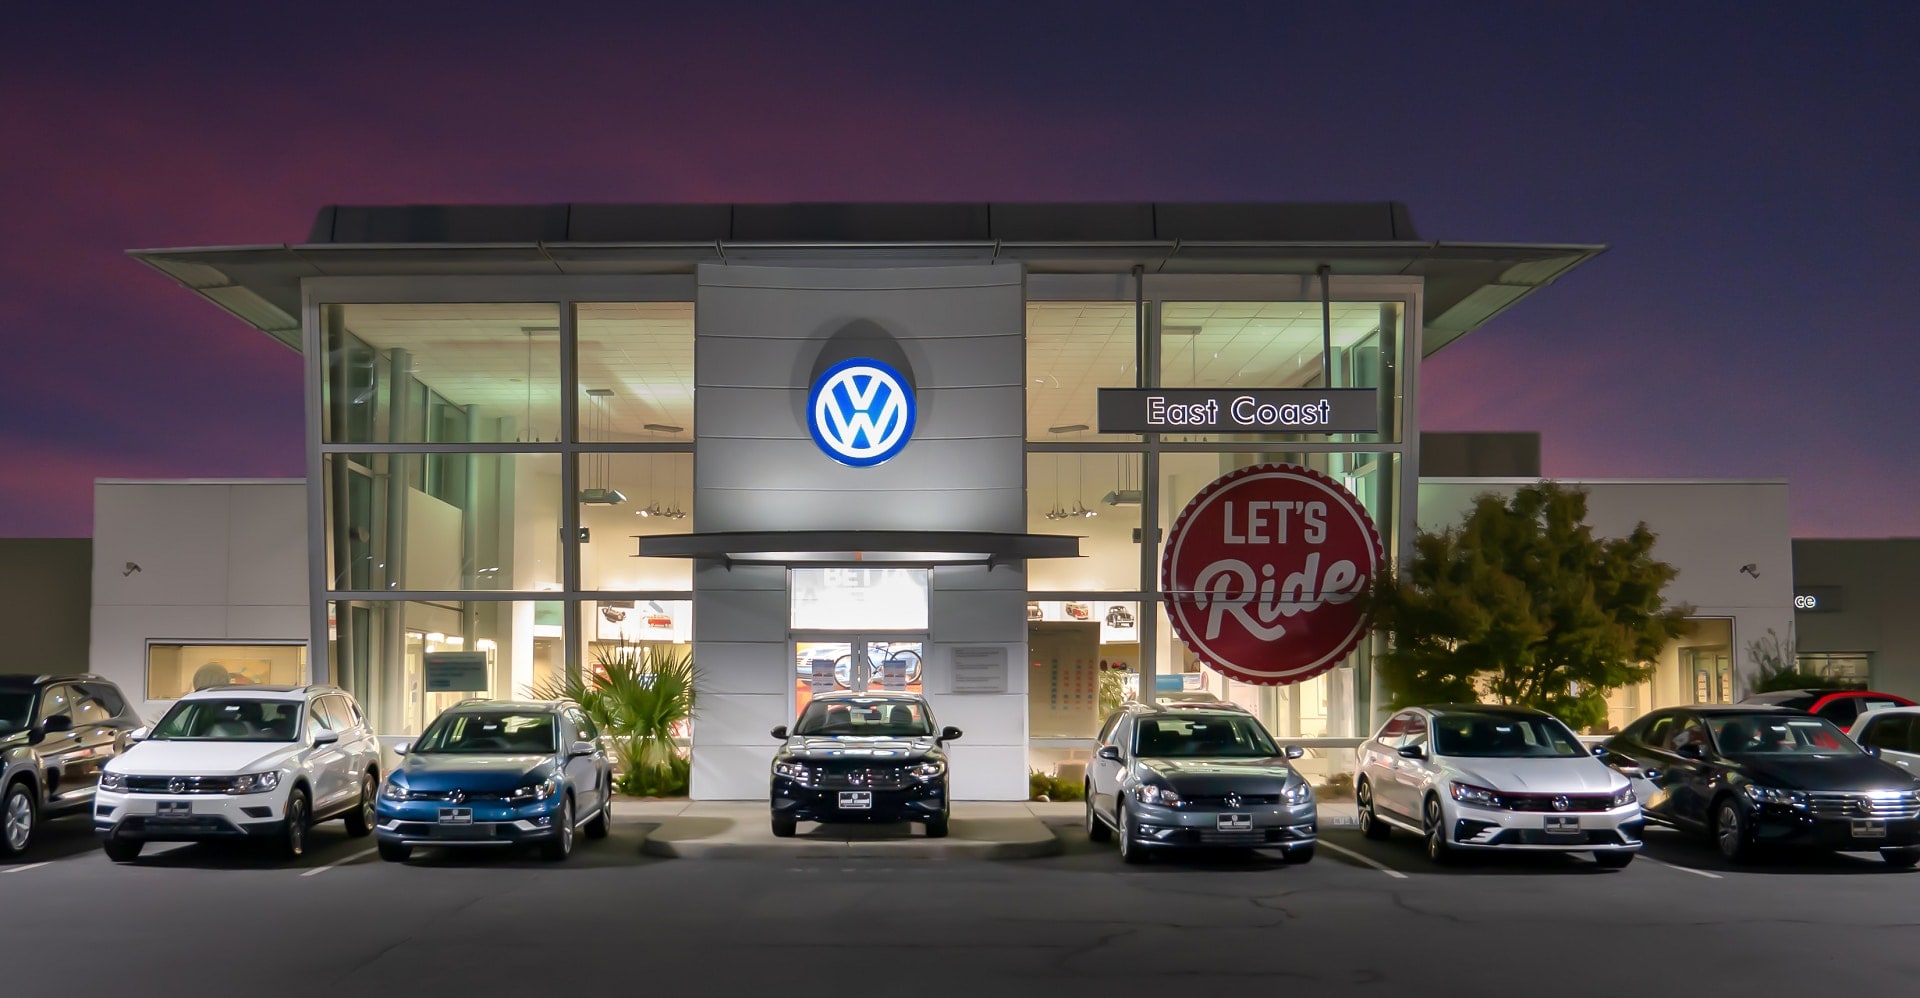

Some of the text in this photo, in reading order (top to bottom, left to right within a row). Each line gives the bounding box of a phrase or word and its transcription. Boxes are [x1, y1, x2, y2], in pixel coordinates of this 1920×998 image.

[1146, 395, 1330, 425] East Coast
[1223, 500, 1328, 545] LET'S
[1193, 551, 1366, 641] Ride
